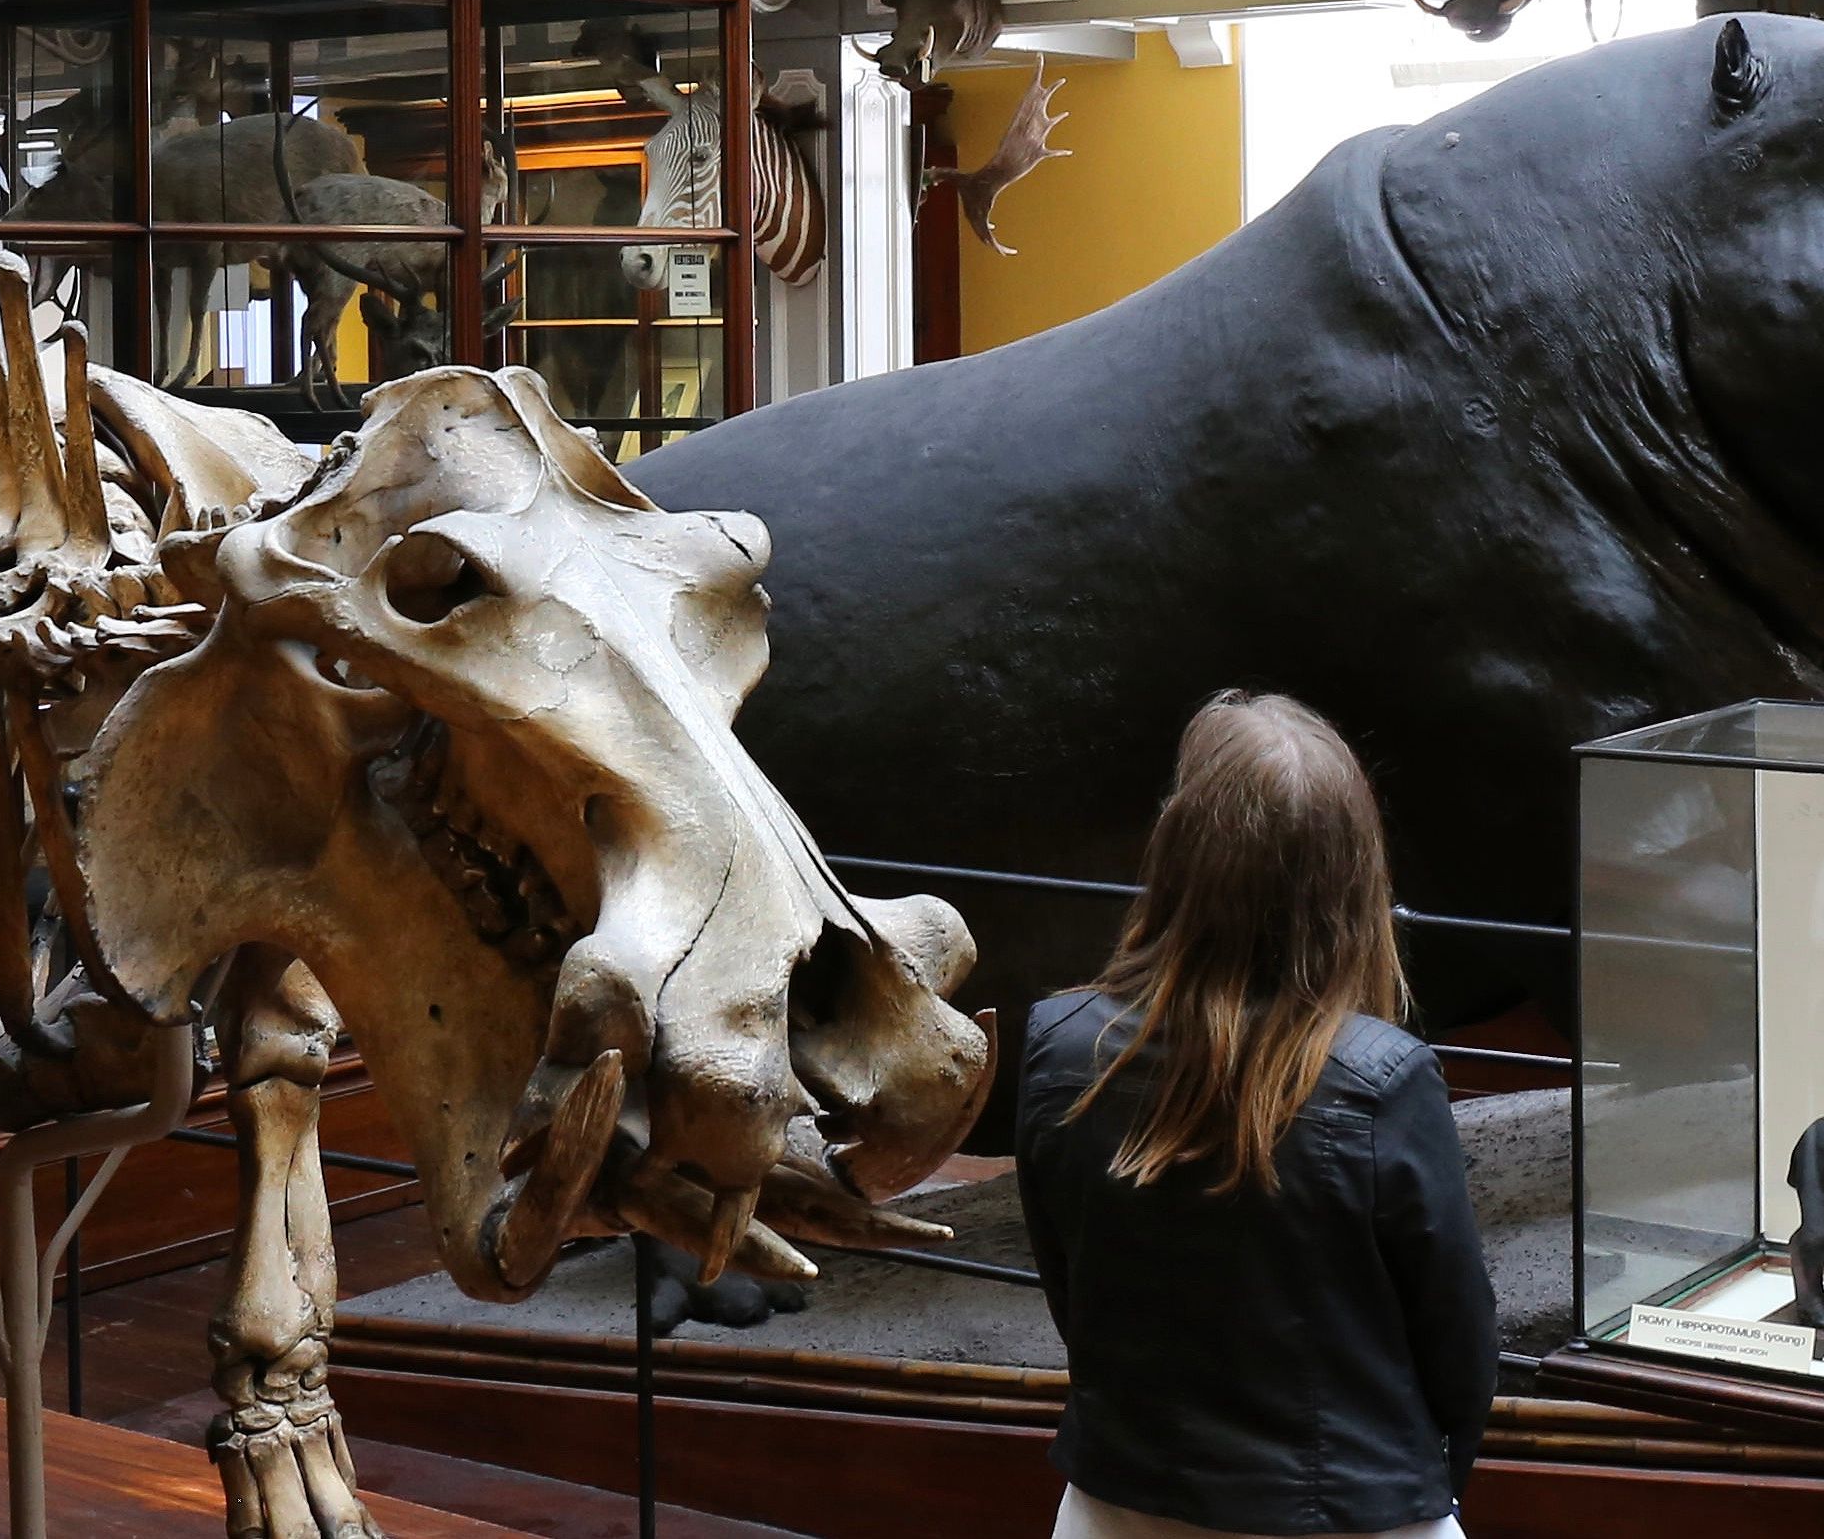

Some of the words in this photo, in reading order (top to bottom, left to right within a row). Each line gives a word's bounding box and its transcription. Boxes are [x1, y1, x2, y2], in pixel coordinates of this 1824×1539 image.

[1637, 1313, 1672, 1328] PIGMY
[1676, 1319, 1762, 1340] HIPPOPOTAMUS
[1764, 1330, 1807, 1347] (young)
